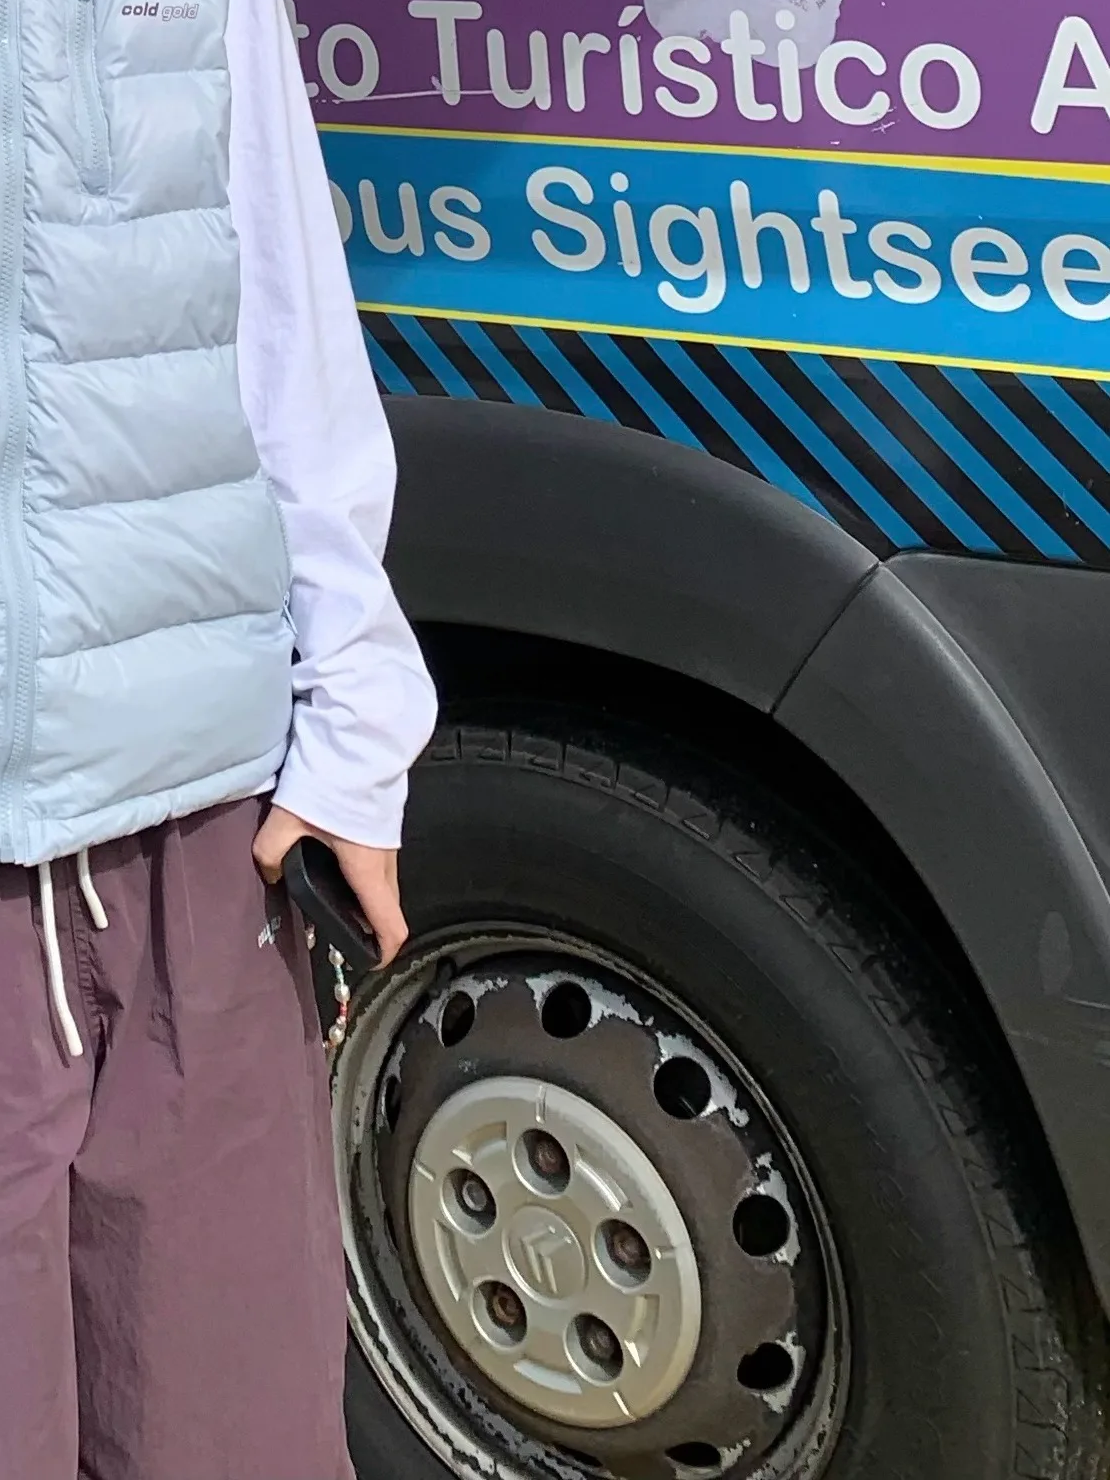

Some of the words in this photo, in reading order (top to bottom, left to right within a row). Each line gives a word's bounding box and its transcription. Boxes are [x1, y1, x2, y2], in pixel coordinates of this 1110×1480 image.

[121, 2, 159, 16] cold
[161, 2, 199, 21] gold
[329, 178, 492, 261] us
[525, 166, 1110, 320] Sightsee
